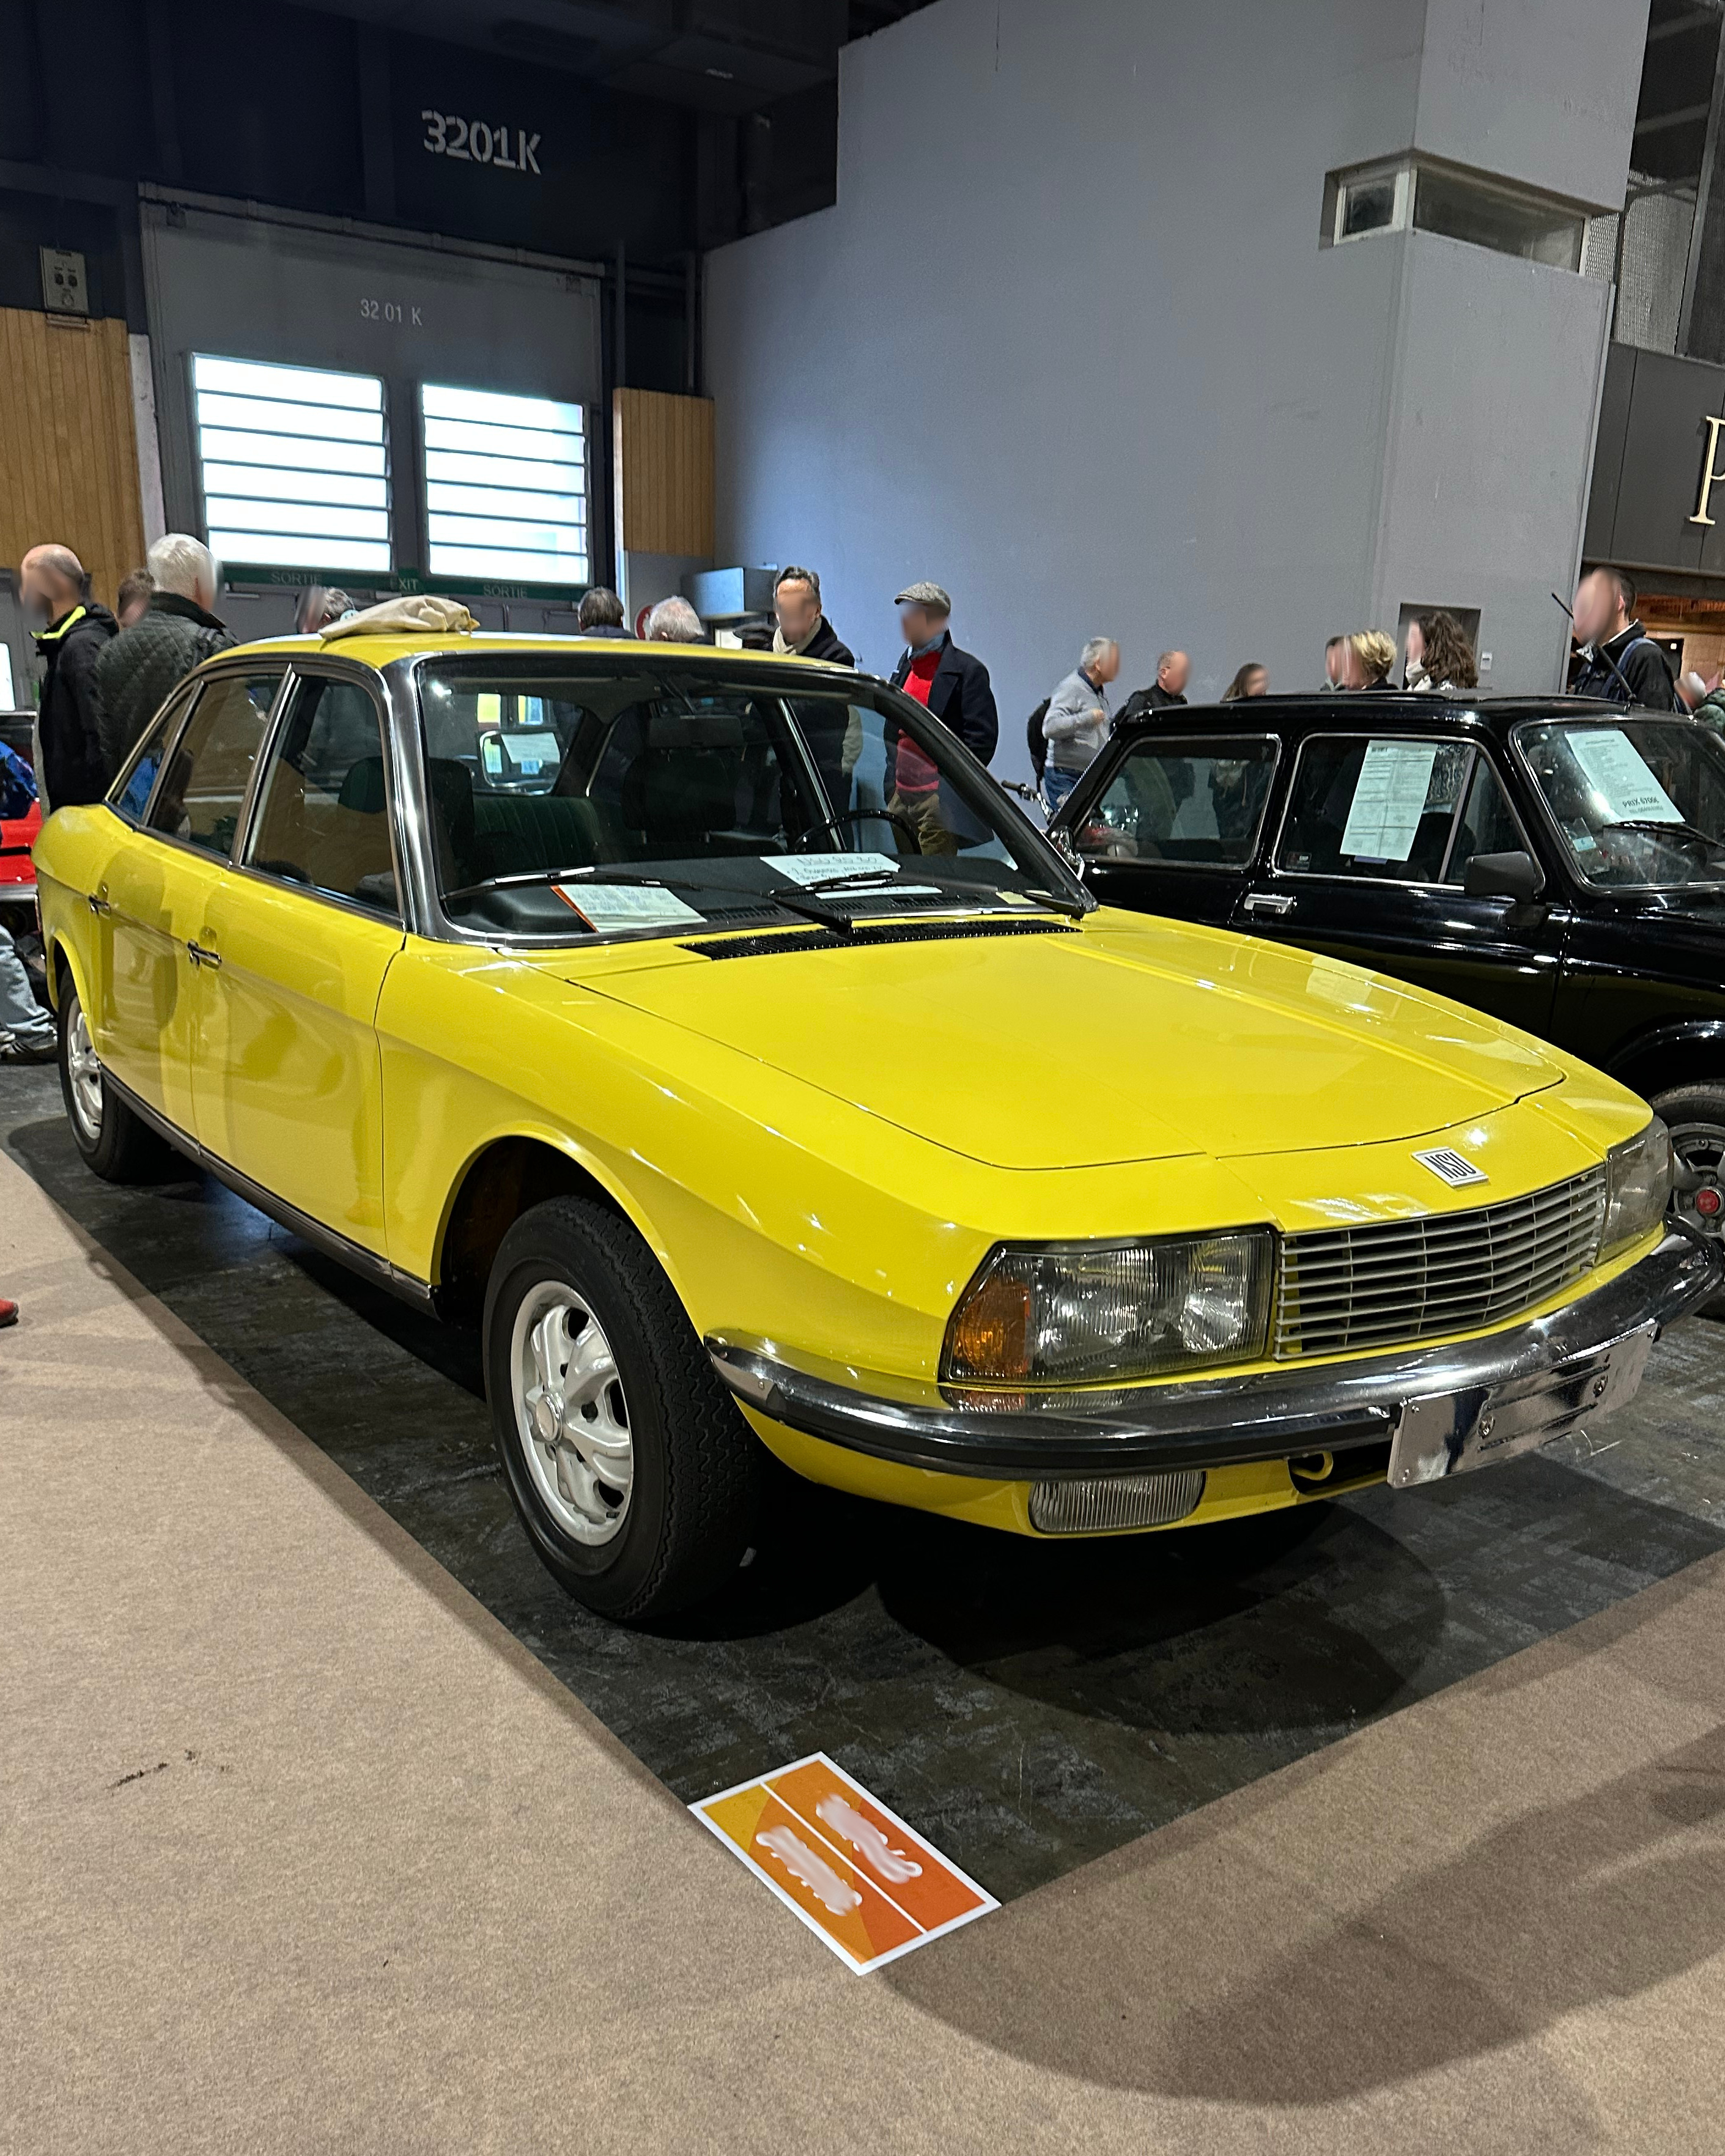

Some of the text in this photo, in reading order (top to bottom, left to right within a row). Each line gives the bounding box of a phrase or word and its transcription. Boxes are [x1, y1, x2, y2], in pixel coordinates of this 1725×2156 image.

[421, 109, 542, 175] 3201K
[411, 306, 422, 326] K
[271, 571, 322, 586] SORTIE
[483, 583, 528, 599] SORTIE
[1424, 1151, 1477, 1179] NSU
